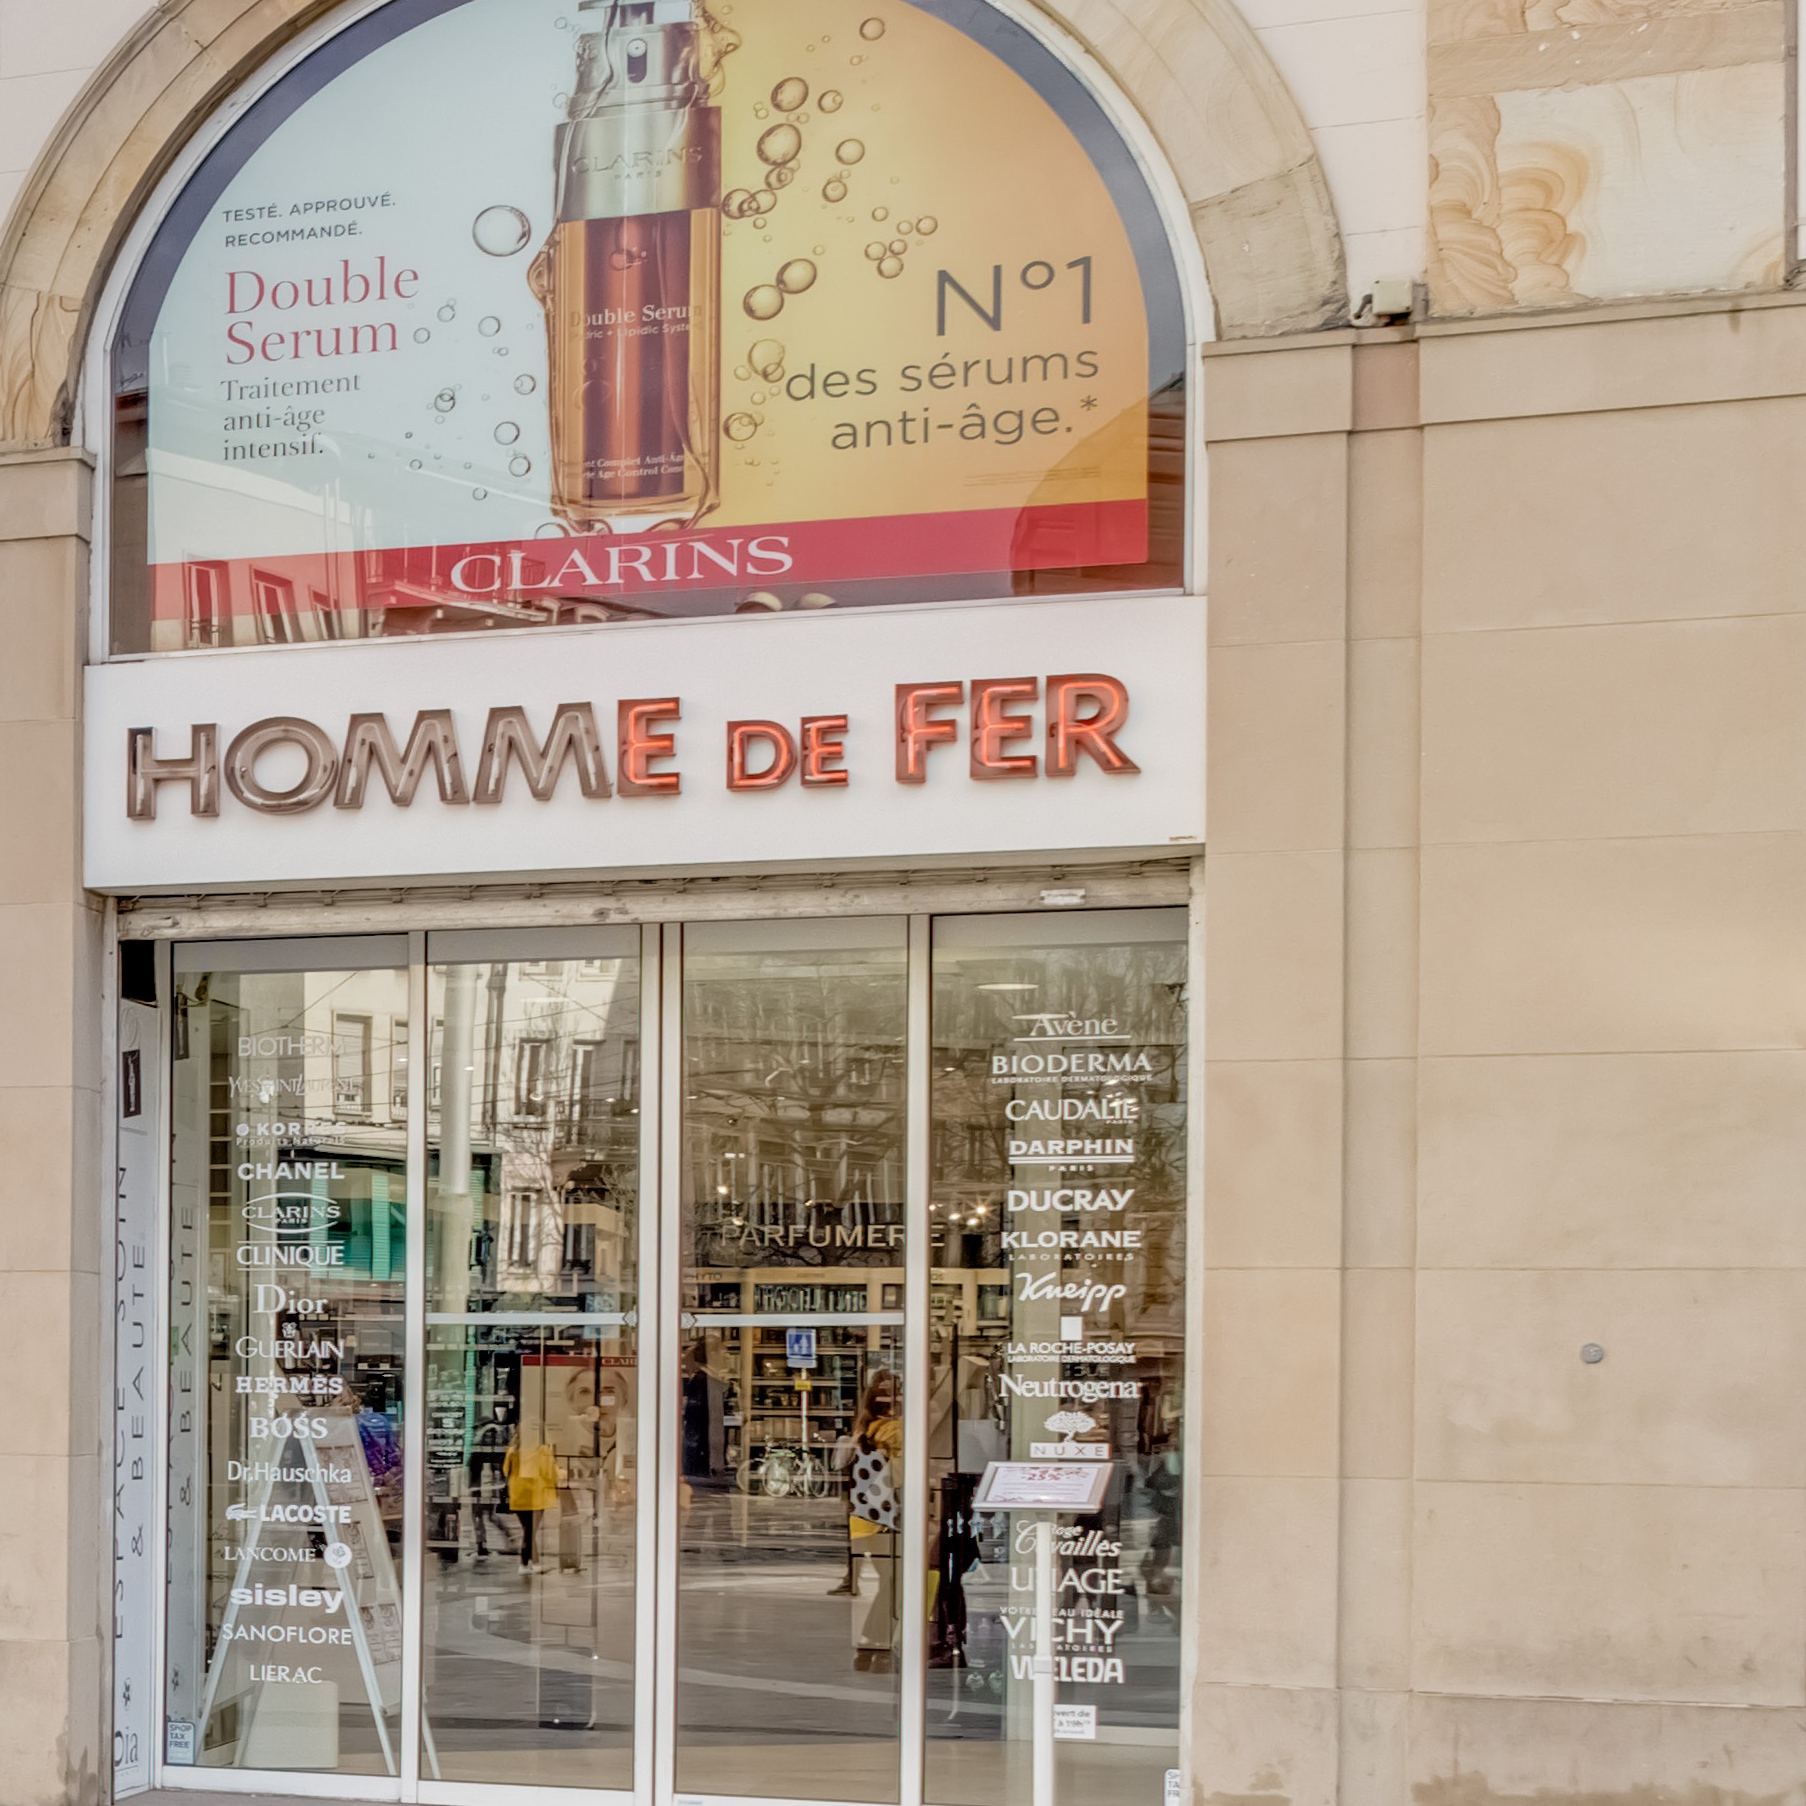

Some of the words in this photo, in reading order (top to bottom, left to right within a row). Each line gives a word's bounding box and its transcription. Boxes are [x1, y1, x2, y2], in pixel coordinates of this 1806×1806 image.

[222, 203, 282, 223] TESTÉ.
[289, 191, 396, 216] APPROUVÉ.
[225, 221, 363, 248] RECOMMANDÉ.
[224, 255, 419, 315] Double
[226, 320, 400, 364] Serum
[220, 374, 360, 401] Traitement
[785, 364, 878, 401] des
[900, 349, 1099, 393] sérums
[223, 405, 325, 431] anti-âge
[223, 431, 324, 461] intensif.
[450, 535, 793, 594] CLARINS
[125, 696, 684, 821] HOMME
[725, 714, 850, 792] DE
[893, 673, 1143, 784] FER
[1029, 1011, 1118, 1037] Avène
[238, 1036, 346, 1057] BIOTHERM
[992, 1053, 1152, 1075] BIODERMA
[256, 1122, 346, 1136] KORRES
[1009, 1138, 1134, 1155] DARPHIN
[237, 1162, 345, 1180] CHANEL
[242, 1206, 341, 1219] CLARINS
[1007, 1189, 1135, 1212] DUCRAY
[722, 1224, 945, 1247] PARFUMERE
[1000, 1230, 1141, 1248] KLORANE
[237, 1246, 345, 1267] CLINIQUE
[252, 1284, 328, 1314] Dior
[1015, 1271, 1127, 1312] Kneipp
[235, 1336, 344, 1359] GUERLAIN
[1007, 1343, 1026, 1354] LA
[1030, 1342, 1136, 1354] ROCHE-POSAY
[131, 1245, 145, 1481] BEAUTE
[998, 1374, 1140, 1403] Neutrogena
[250, 1416, 328, 1439] BOSS
[1034, 1445, 1105, 1457] NUXE
[260, 1504, 352, 1523] LACOSTE
[1011, 1567, 1126, 1594] UIAGE
[230, 1583, 344, 1613] sisley
[222, 1624, 352, 1645] SANOFLORE
[1000, 1616, 1124, 1644] VICHY
[250, 1664, 322, 1683] LIERAC
